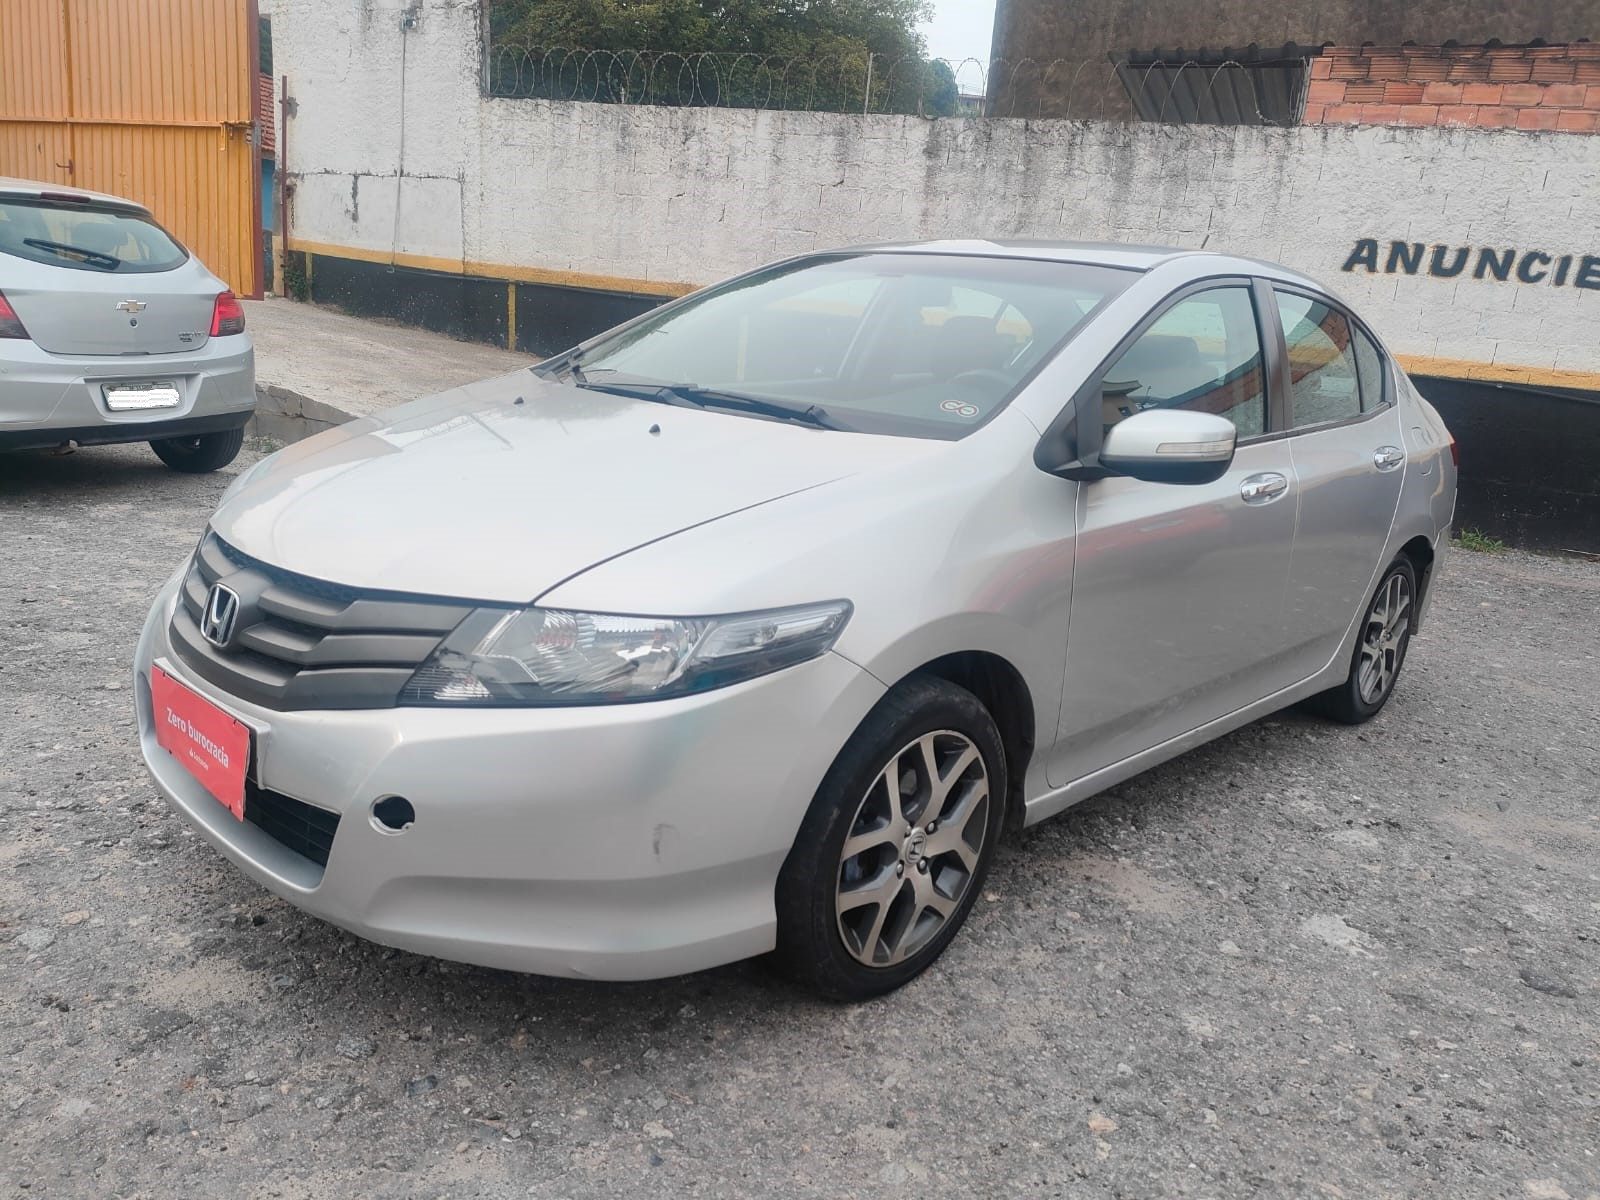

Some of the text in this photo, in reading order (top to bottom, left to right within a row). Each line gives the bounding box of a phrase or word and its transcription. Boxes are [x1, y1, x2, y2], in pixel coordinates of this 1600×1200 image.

[1342, 238, 1600, 290] ANUNCIE
[167, 707, 186, 732] Zero
[188, 719, 229, 768] burocracia
